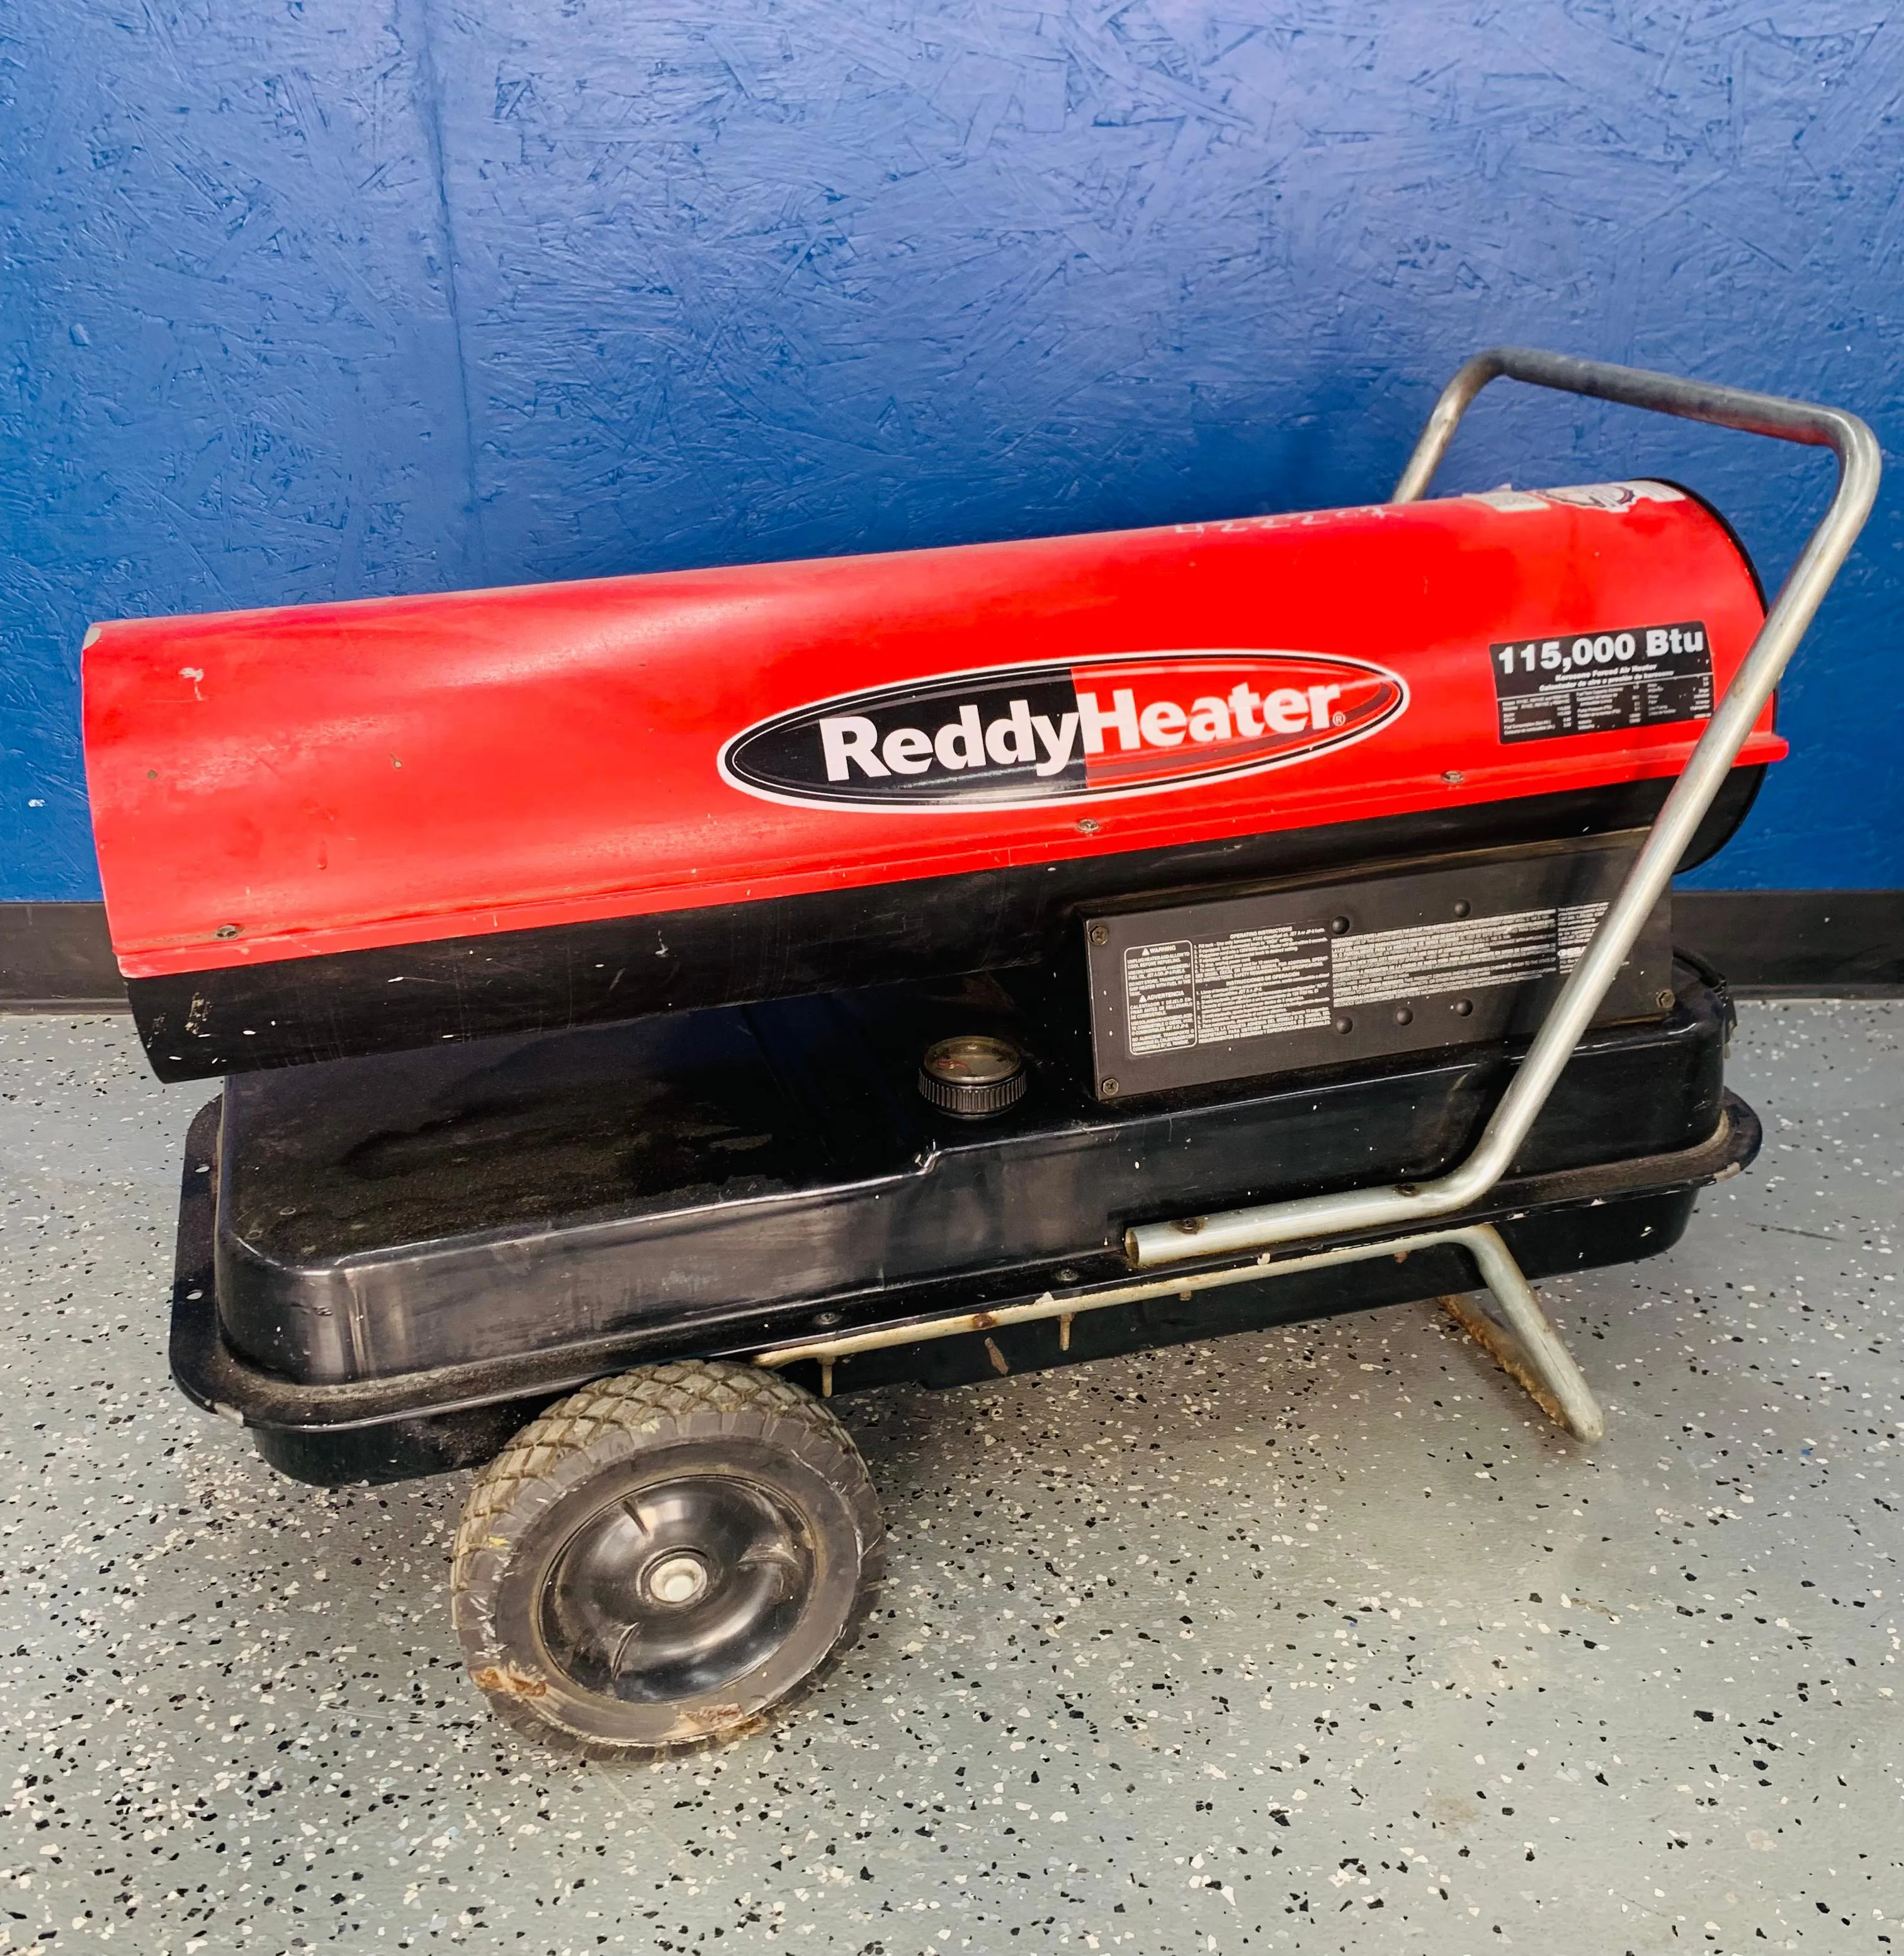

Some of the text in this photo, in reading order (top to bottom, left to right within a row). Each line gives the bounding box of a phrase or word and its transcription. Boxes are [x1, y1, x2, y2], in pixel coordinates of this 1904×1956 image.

[1499, 628, 1704, 674] 115,000 Btu
[1149, 945, 1176, 953] WARNING
[1147, 991, 1184, 1001] ADVERTENCIA
